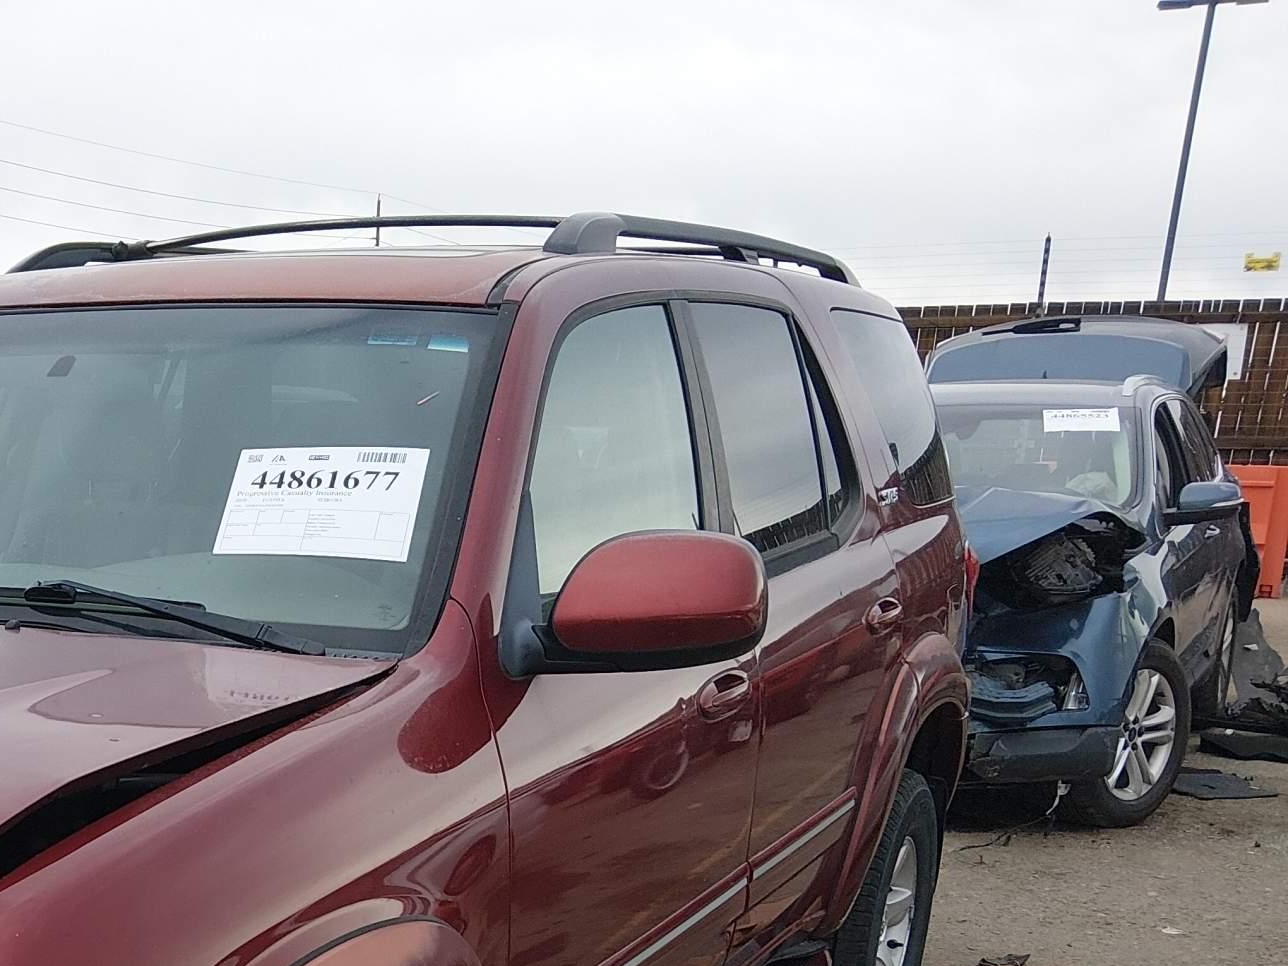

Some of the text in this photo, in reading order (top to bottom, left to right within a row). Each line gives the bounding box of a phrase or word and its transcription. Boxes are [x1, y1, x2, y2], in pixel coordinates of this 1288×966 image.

[251, 470, 400, 491] 44861677
[236, 489, 353, 498] Progressive Casualty Insurance
